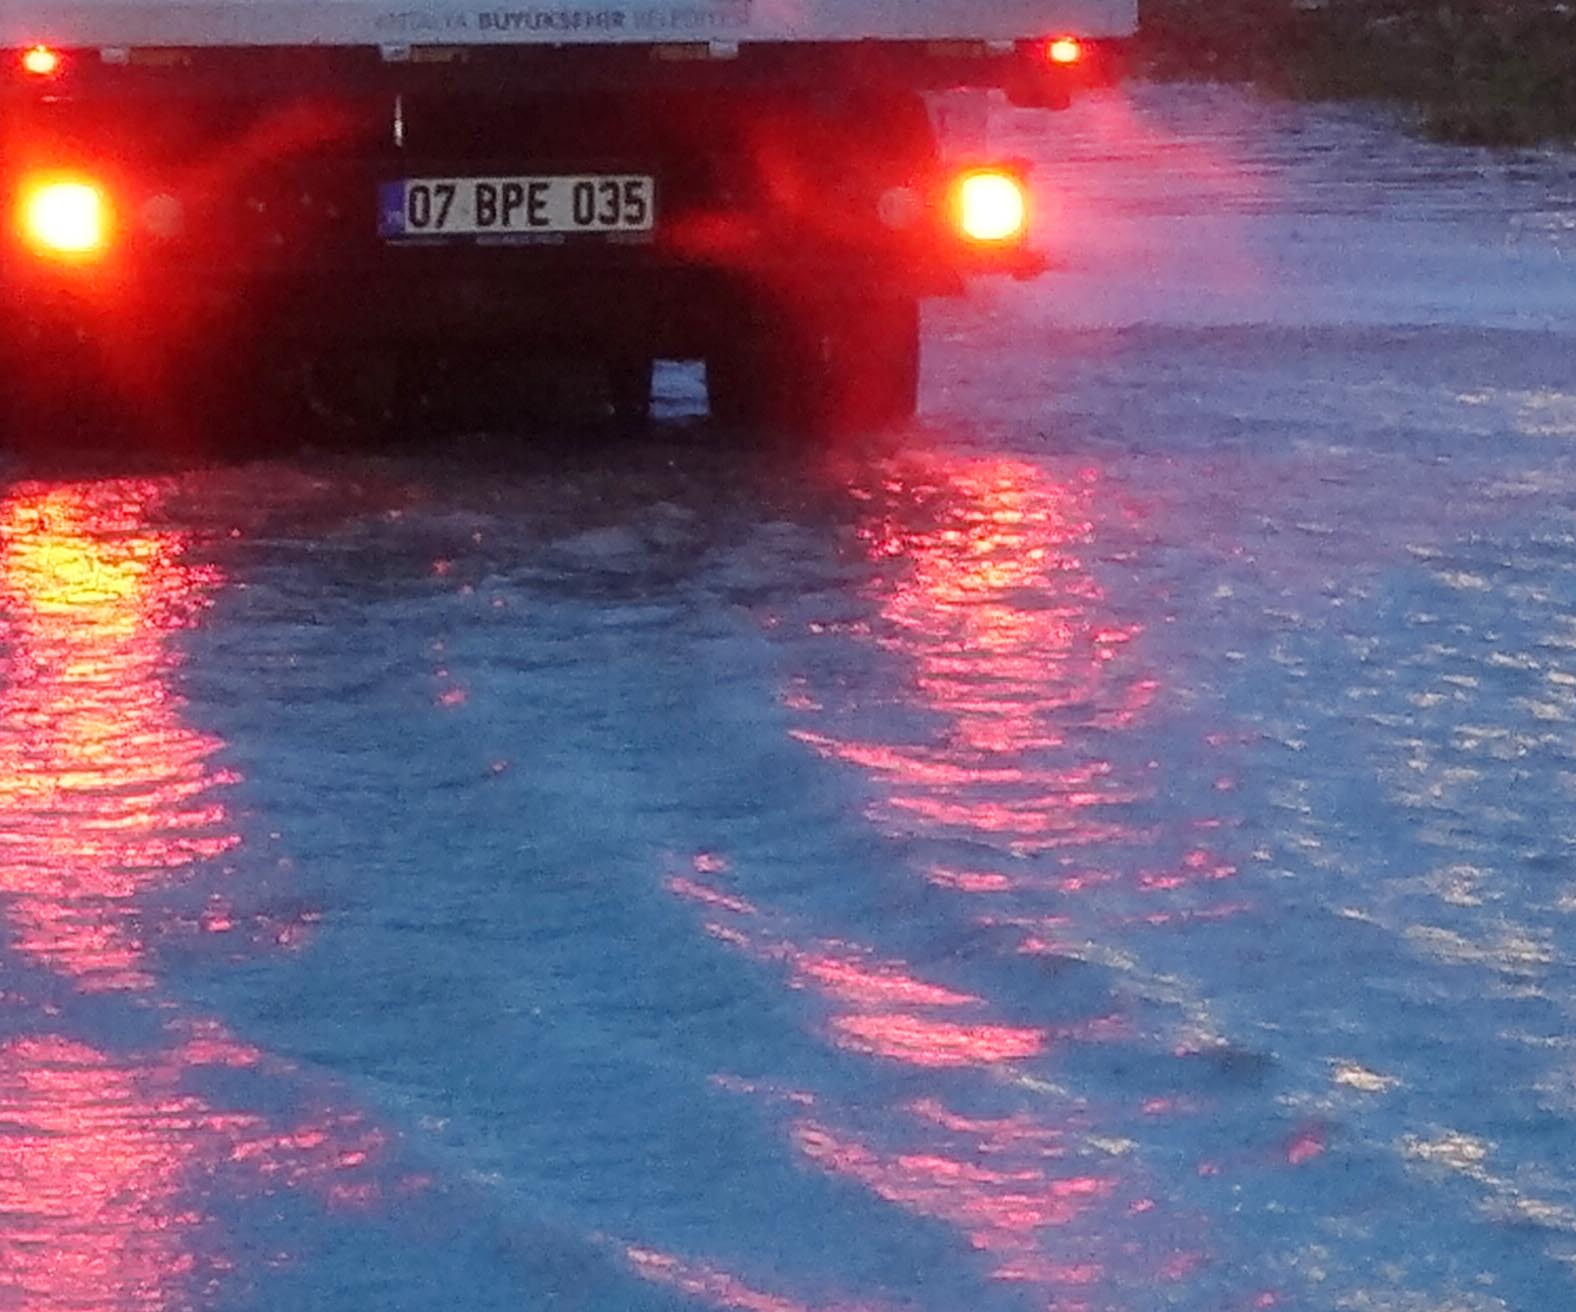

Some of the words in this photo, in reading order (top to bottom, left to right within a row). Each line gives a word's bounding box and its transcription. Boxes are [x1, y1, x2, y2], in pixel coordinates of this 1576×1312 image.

[408, 185, 456, 229] 07
[475, 182, 552, 228] BPE
[572, 180, 646, 226] 035
